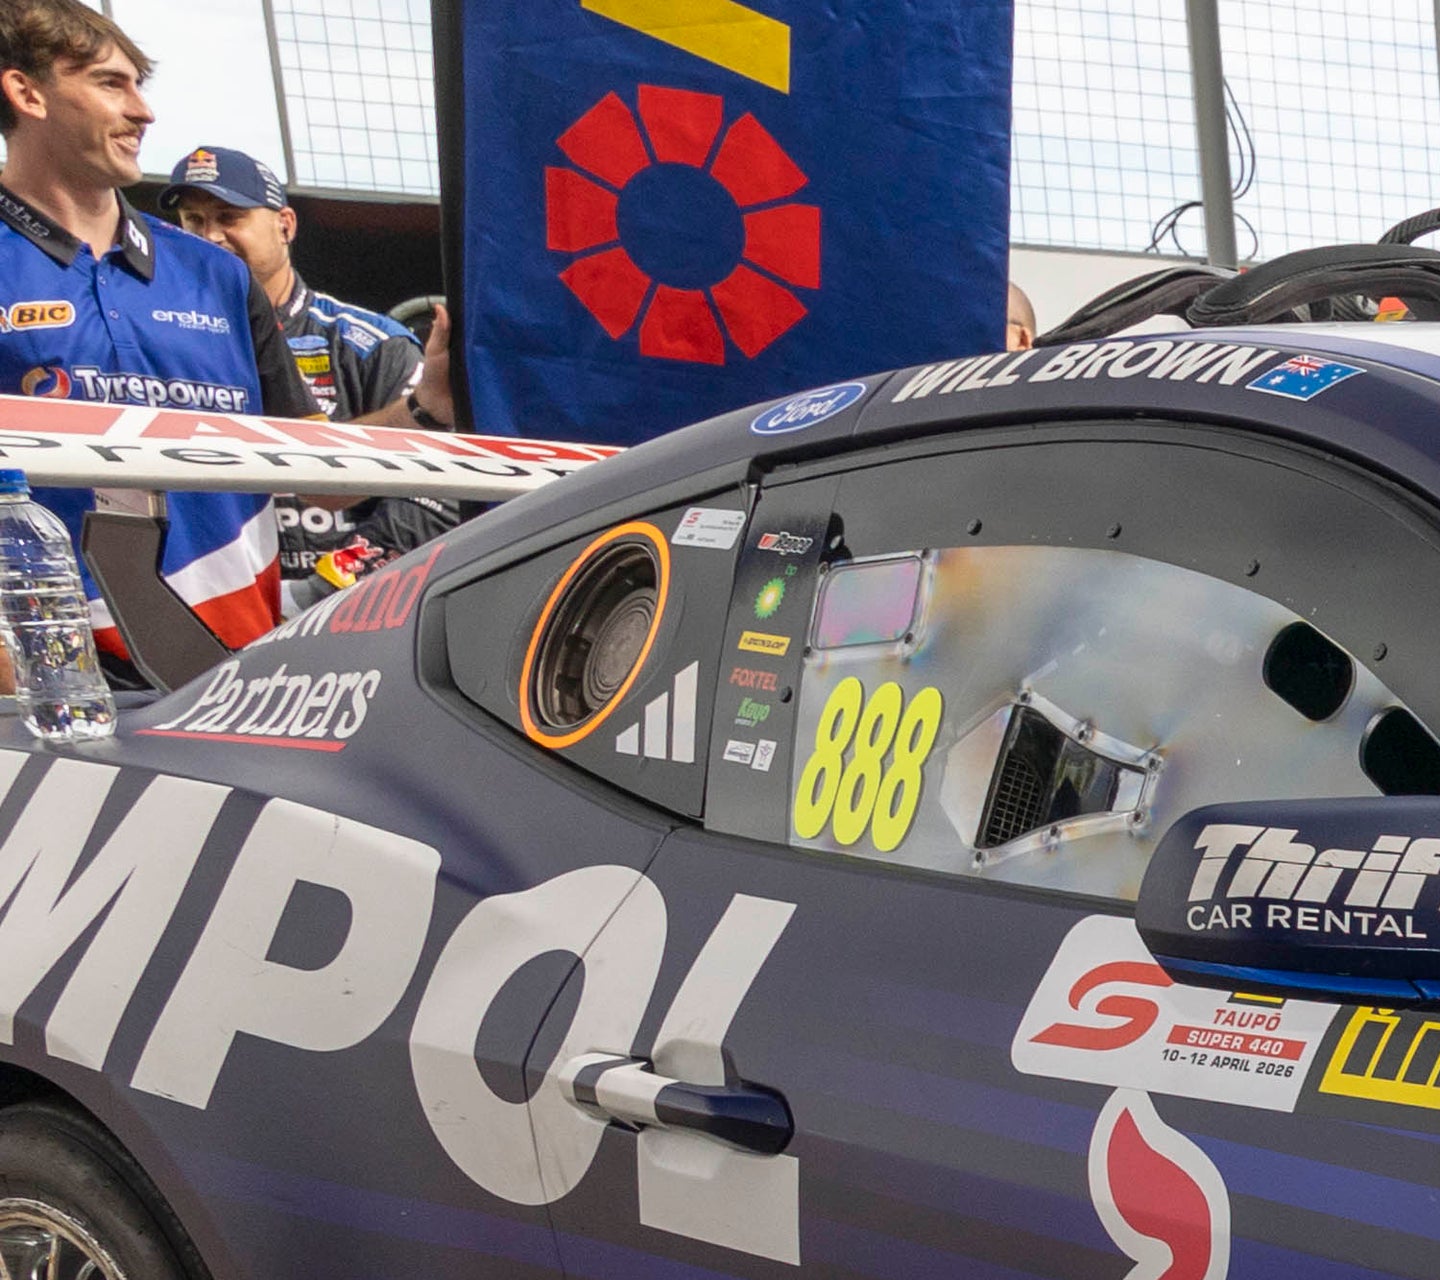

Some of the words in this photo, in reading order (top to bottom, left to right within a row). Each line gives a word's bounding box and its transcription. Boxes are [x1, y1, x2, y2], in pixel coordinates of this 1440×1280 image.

[151, 309, 230, 329] erebus
[75, 366, 248, 412] Tyrepower
[893, 346, 1033, 402] WILL
[1036, 338, 1281, 387] BROWN
[764, 388, 853, 431] Ford
[277, 506, 357, 534] POL
[728, 667, 778, 691] FOXTEL
[160, 660, 383, 740] Partners
[795, 676, 943, 854] 888
[1186, 905, 1251, 932] CAR
[1267, 905, 1427, 939] RENTAL
[0, 750, 800, 1266] MPOL
[1186, 1031, 1244, 1051] SUPER
[1248, 1040, 1285, 1056] 440
[1211, 1056, 1252, 1073] APRIL
[1257, 1062, 1295, 1078] 2026
